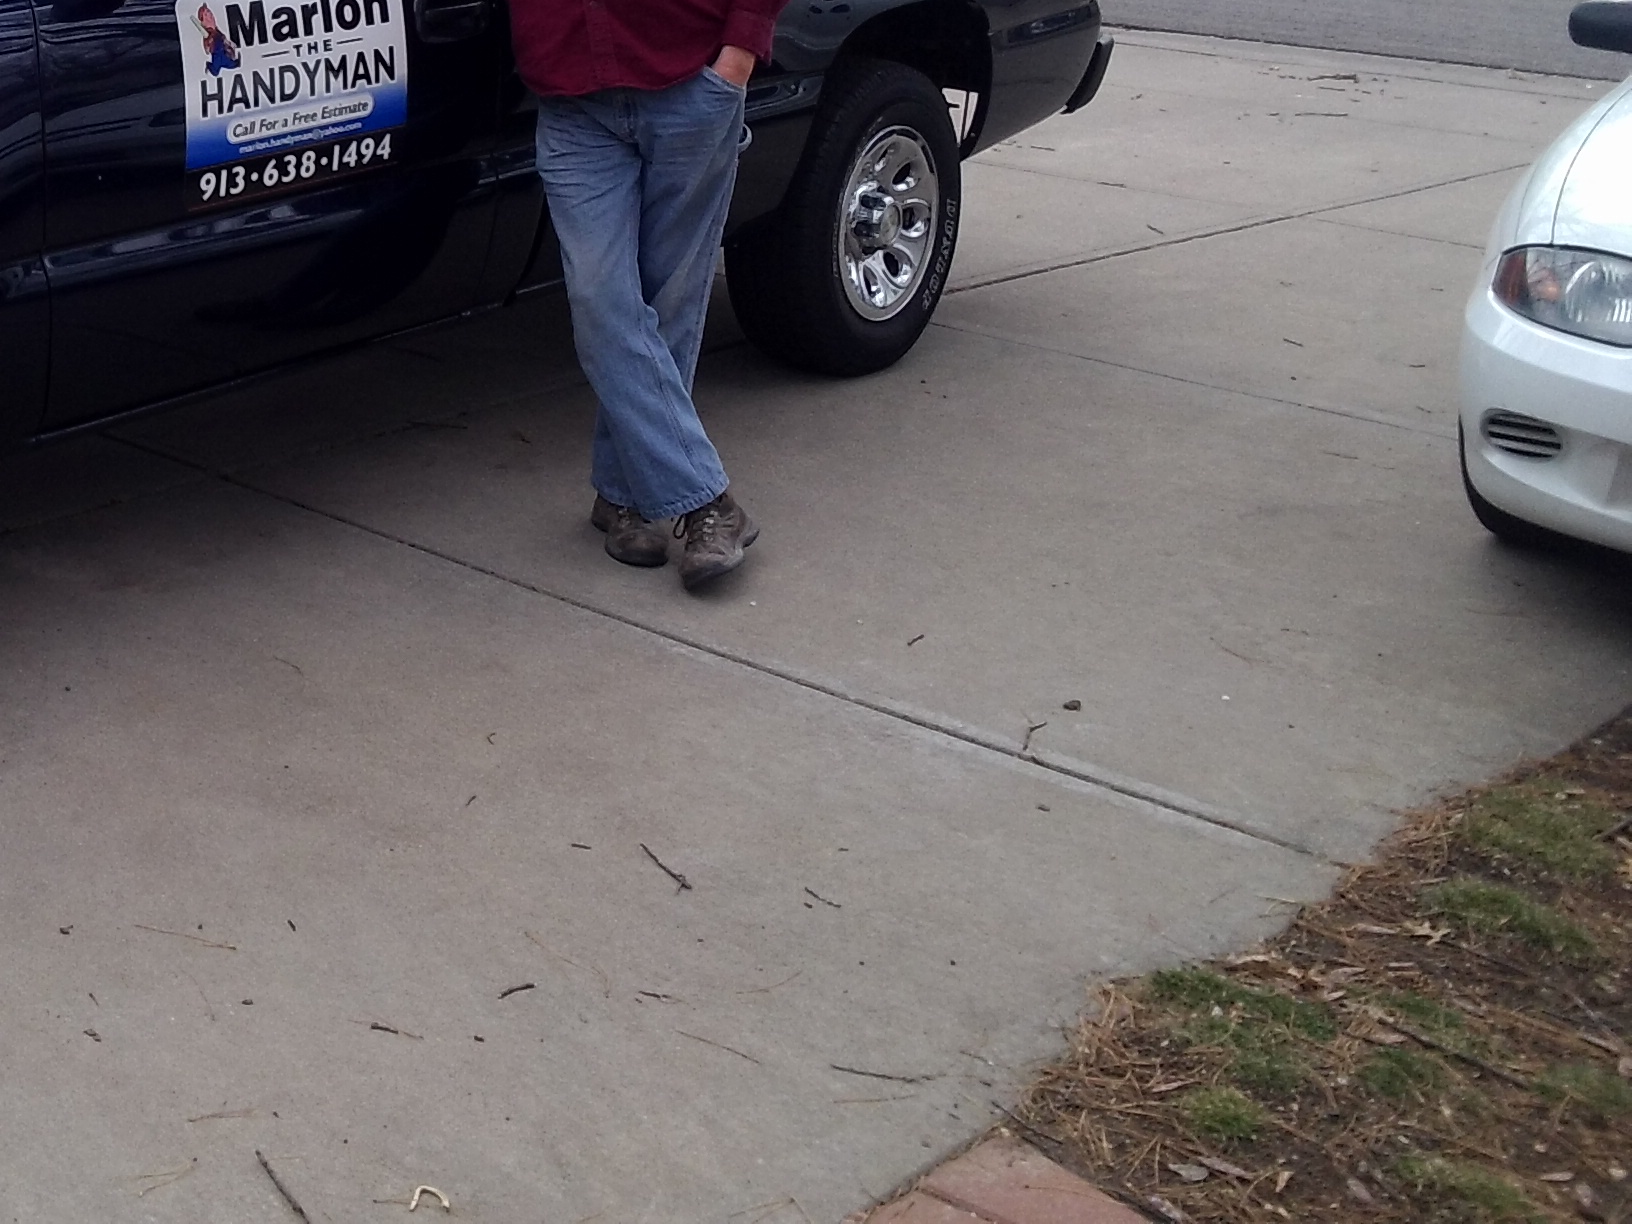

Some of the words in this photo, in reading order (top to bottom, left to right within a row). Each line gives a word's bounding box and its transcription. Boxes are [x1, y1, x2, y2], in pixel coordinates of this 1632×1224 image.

[292, 39, 334, 58] THE
[200, 45, 396, 118] HANDYMAN
[232, 120, 256, 138] Call
[259, 118, 279, 133] For
[282, 118, 288, 128] a
[292, 111, 318, 125] Free
[321, 102, 369, 119] Estimate
